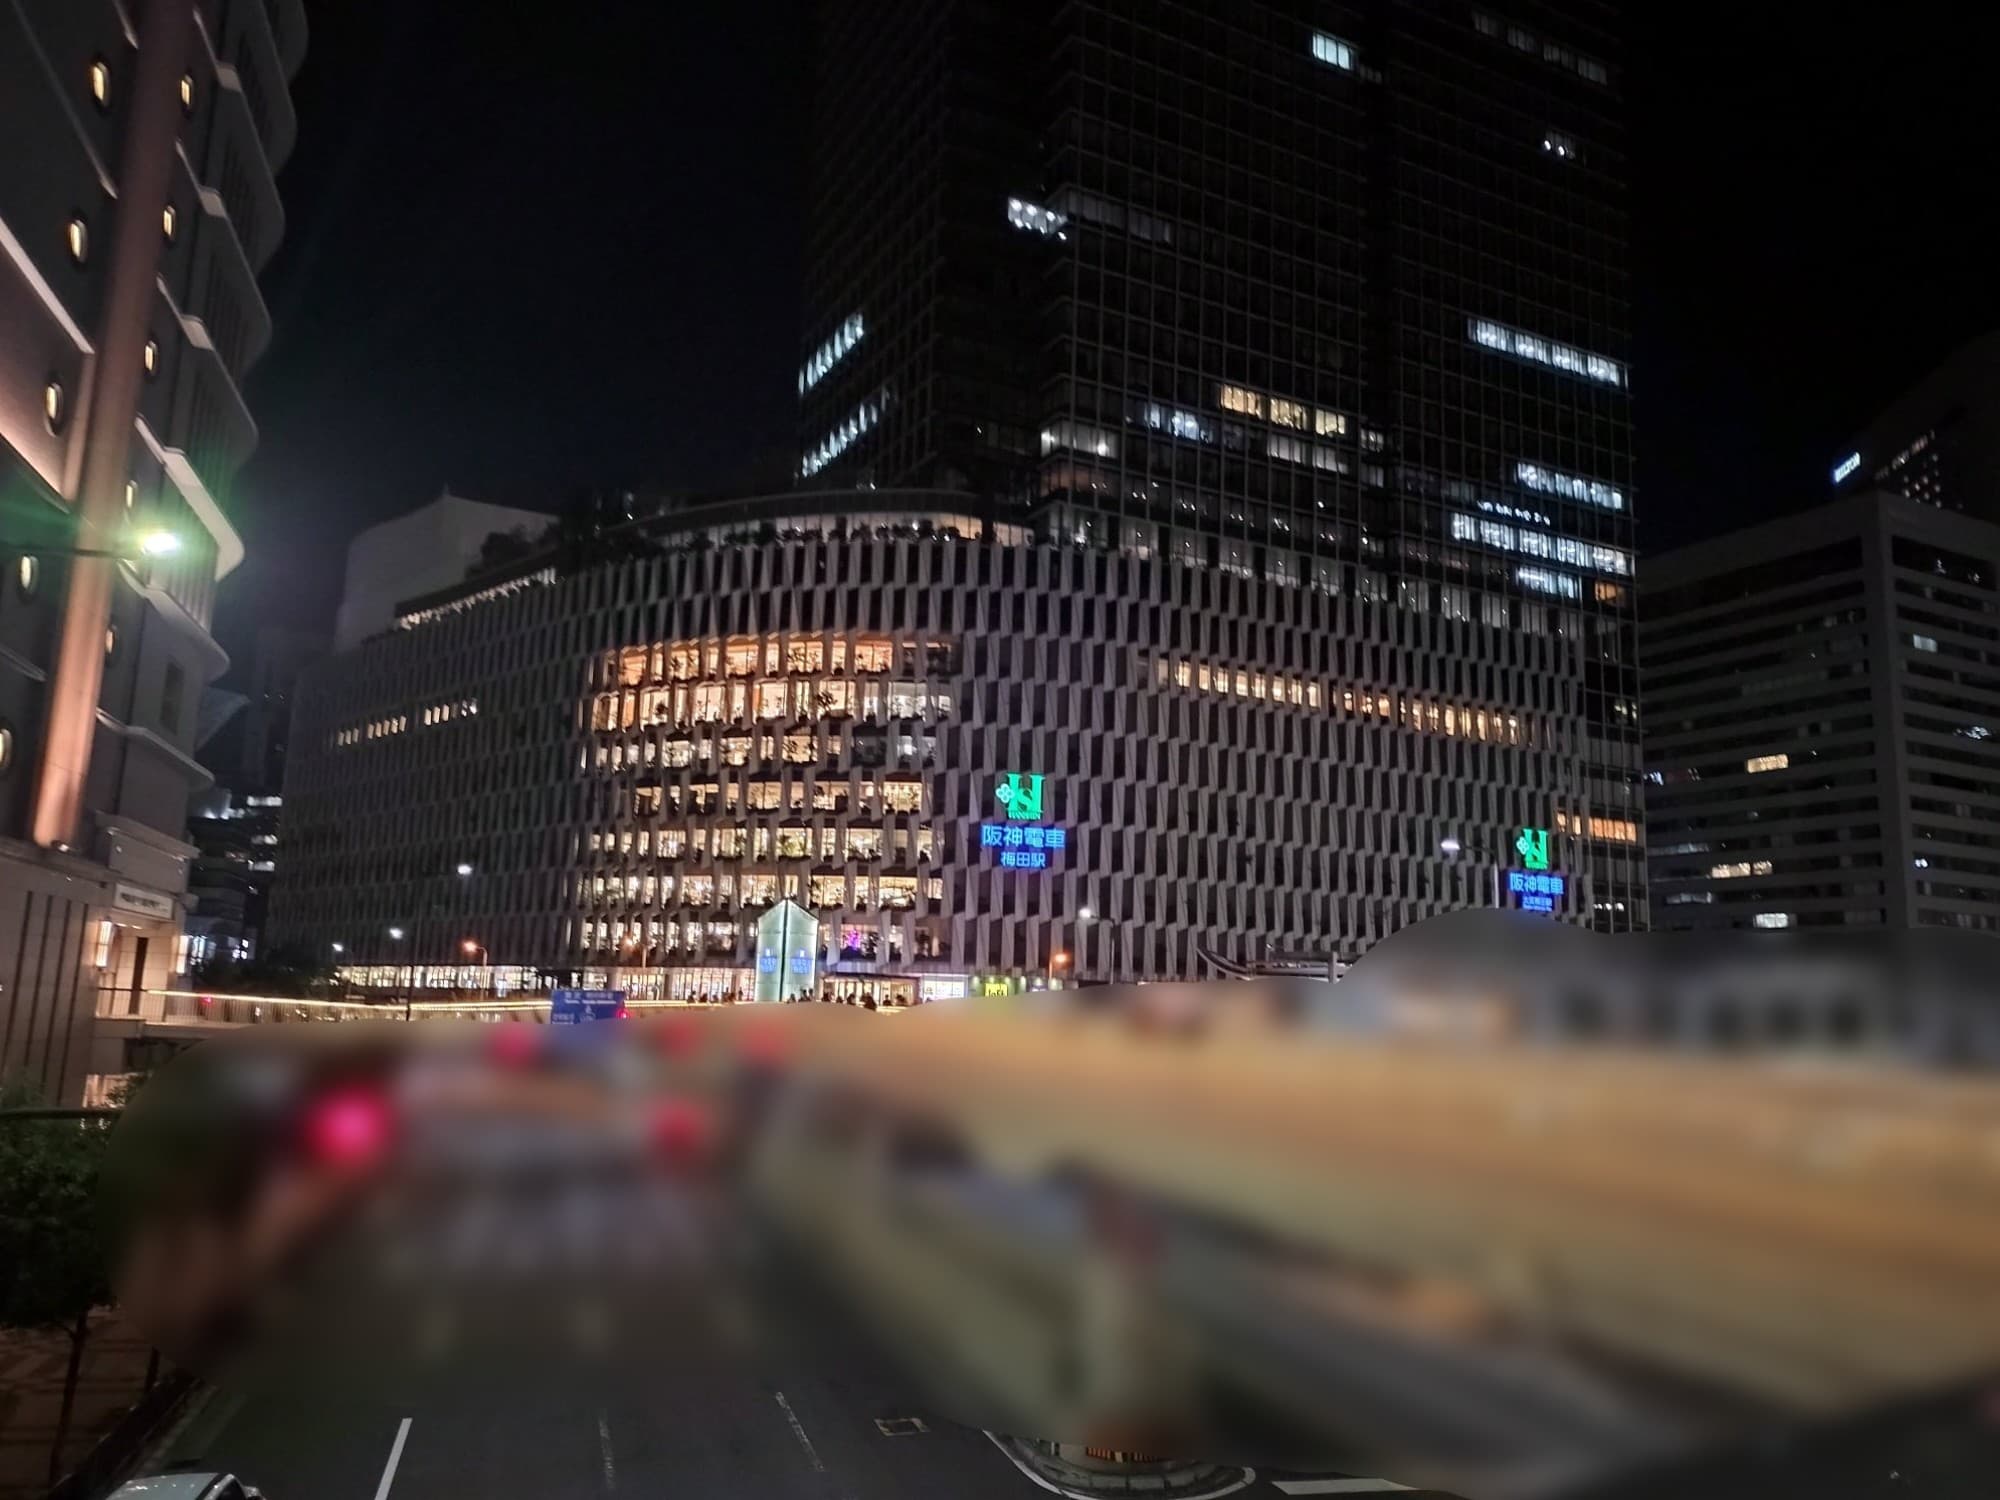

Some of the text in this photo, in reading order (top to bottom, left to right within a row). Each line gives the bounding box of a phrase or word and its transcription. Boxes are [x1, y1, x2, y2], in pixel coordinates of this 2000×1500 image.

[981, 825, 1065, 848] 阪神電車
[1001, 851, 1046, 867] 梅田駅
